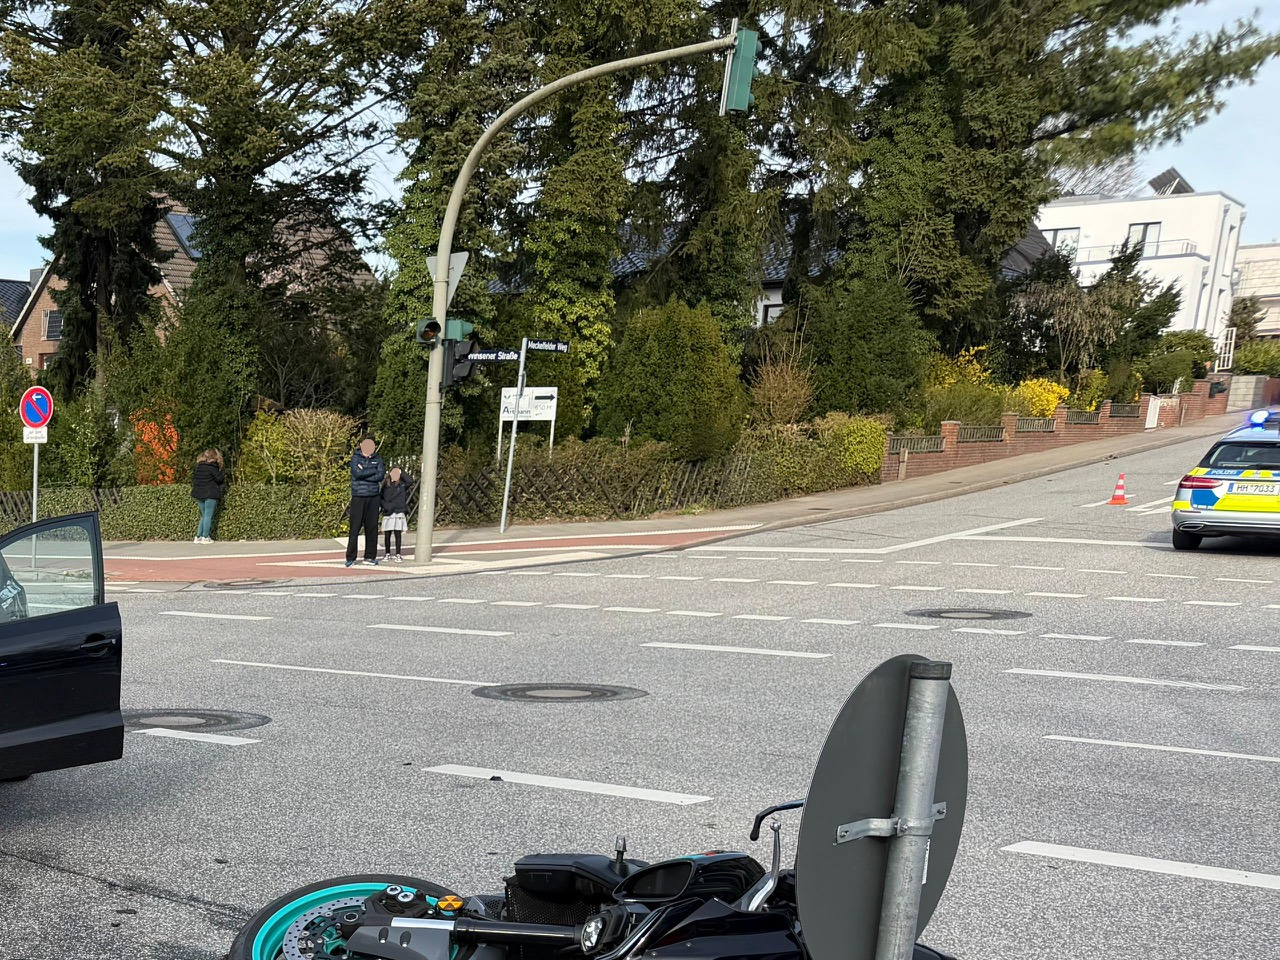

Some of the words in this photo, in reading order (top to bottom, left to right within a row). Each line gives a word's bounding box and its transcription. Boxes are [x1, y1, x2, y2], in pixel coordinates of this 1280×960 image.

[557, 342, 567, 353] Weg
[497, 351, 518, 360] Straße
[1236, 484, 1249, 492] HH
